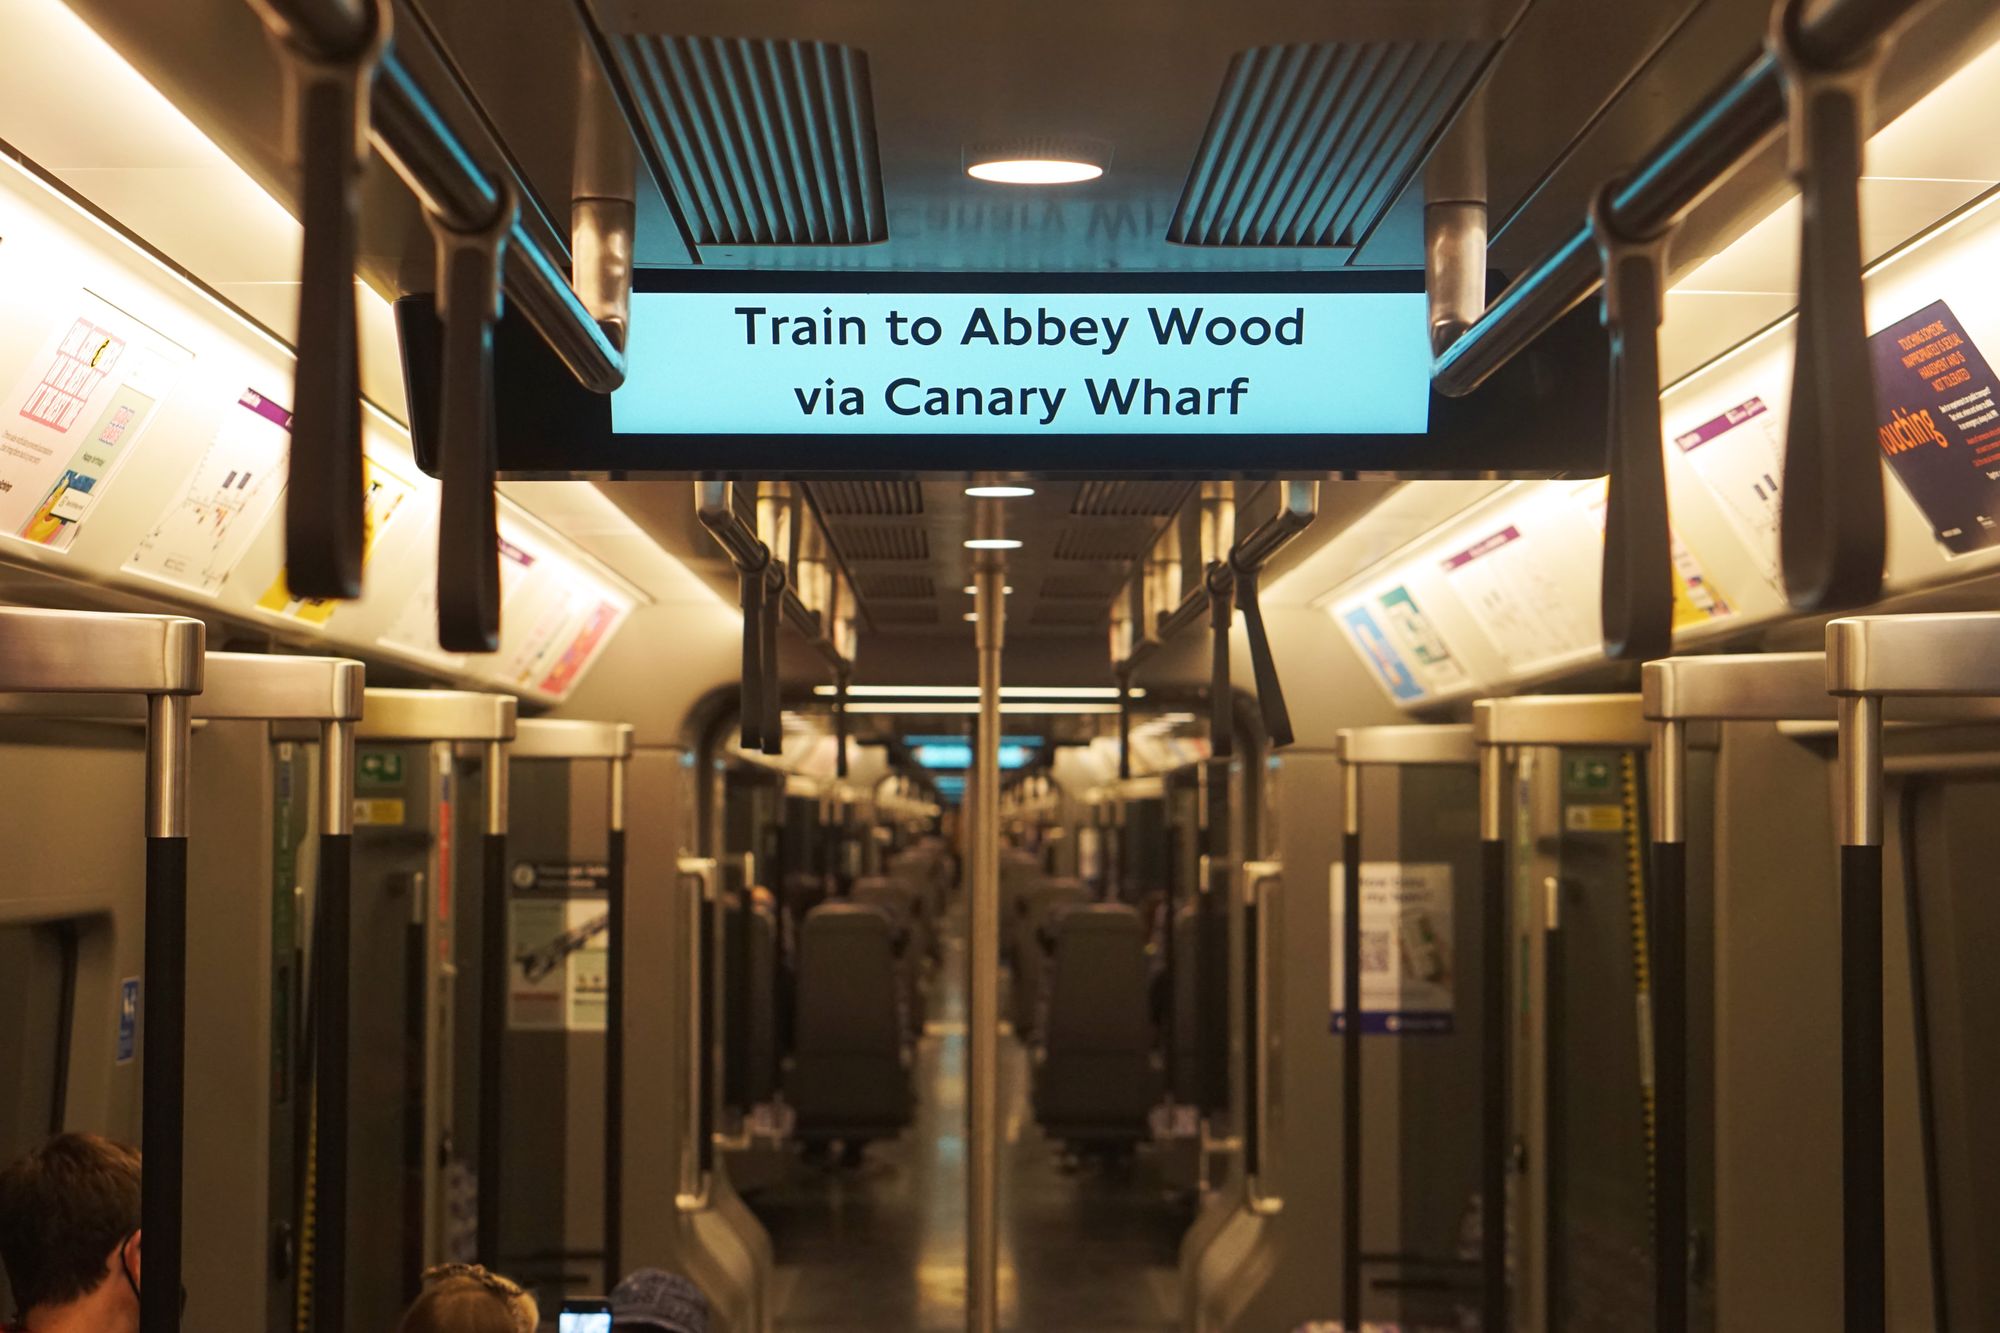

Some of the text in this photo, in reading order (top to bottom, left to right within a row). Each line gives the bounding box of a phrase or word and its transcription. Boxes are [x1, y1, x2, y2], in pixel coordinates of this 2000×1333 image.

[735, 307, 1304, 355] Train to Abbey Wood
[794, 377, 1250, 425] via Canary Wharf
